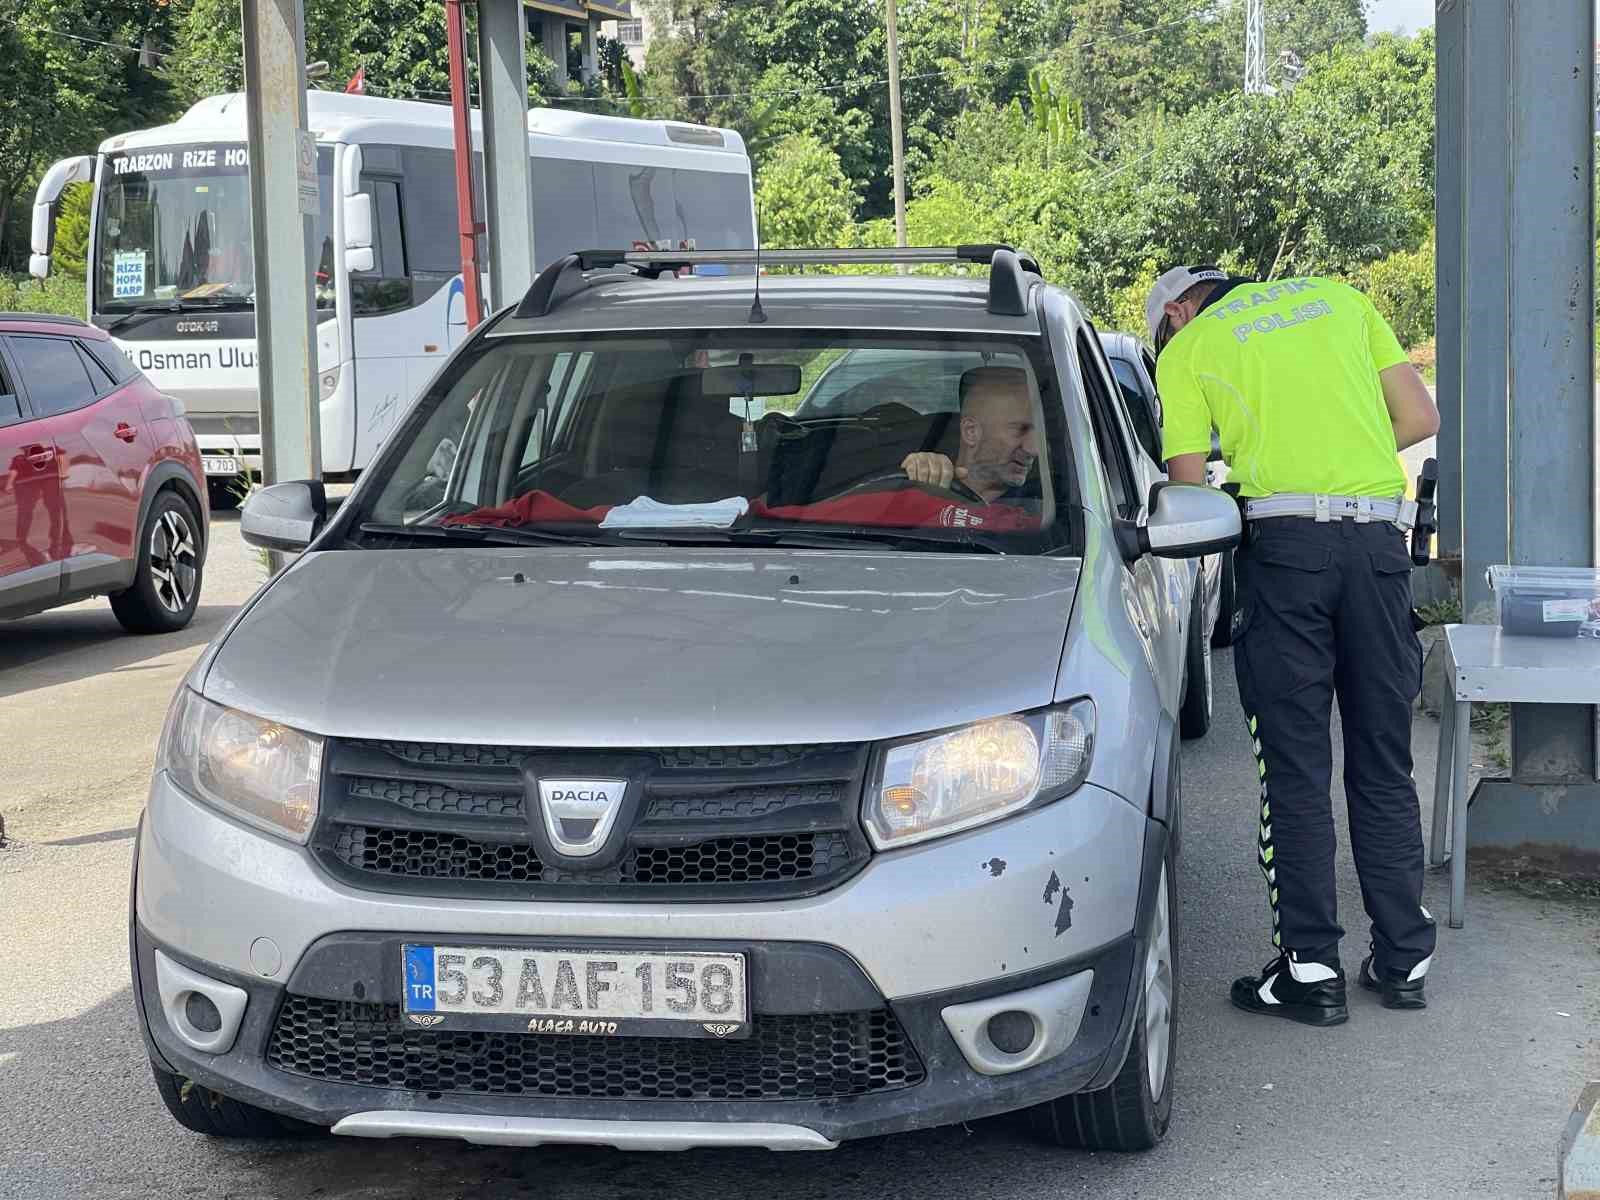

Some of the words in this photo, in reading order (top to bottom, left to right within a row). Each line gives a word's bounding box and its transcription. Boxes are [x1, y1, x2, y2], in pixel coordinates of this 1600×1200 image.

[112, 153, 173, 175] TRABZON
[116, 274, 142, 285] HOPA
[140, 350, 211, 370] Osman
[217, 459, 234, 472] 703
[551, 791, 608, 802] DACIA
[412, 984, 433, 1000] TR
[438, 955, 504, 1008] 53
[515, 958, 617, 1010] AAF
[635, 961, 734, 1015] 158
[578, 1020, 618, 1034] AUTO
